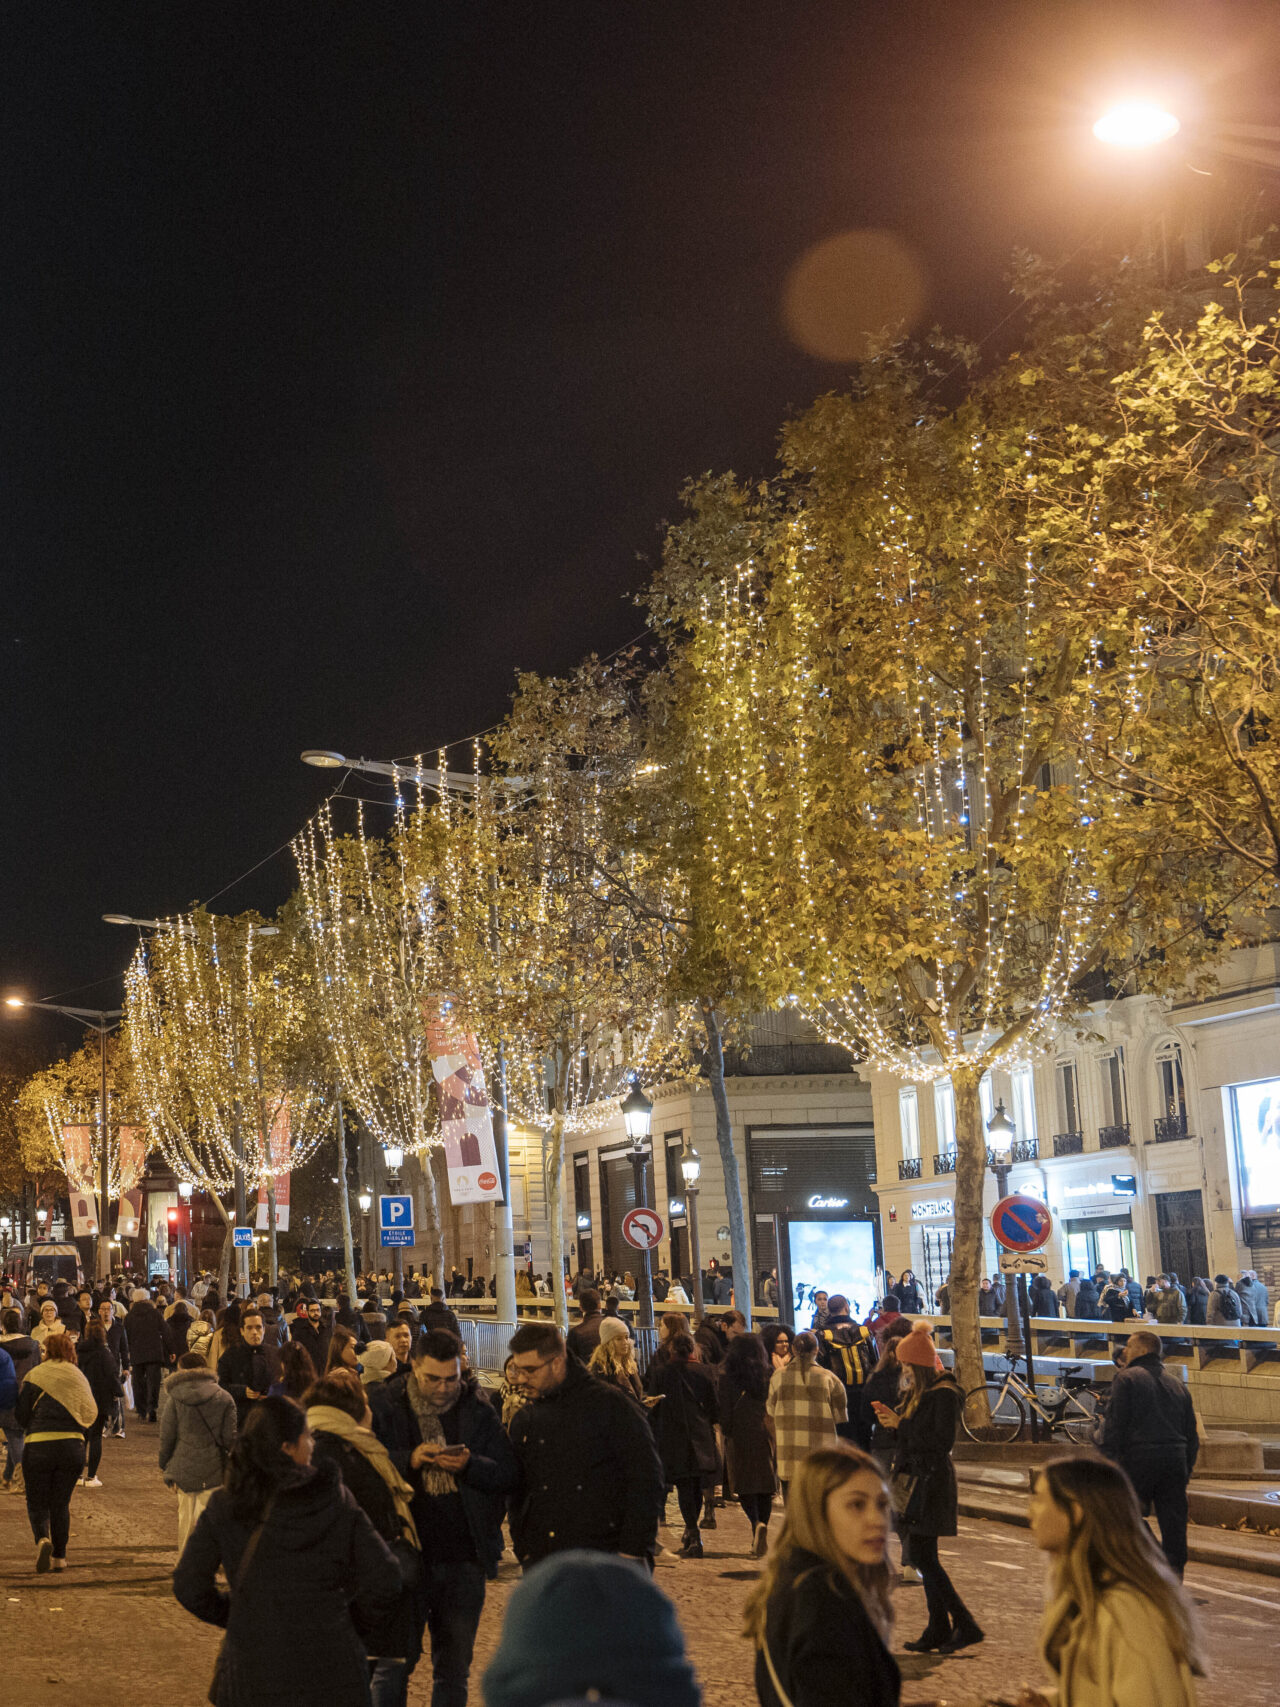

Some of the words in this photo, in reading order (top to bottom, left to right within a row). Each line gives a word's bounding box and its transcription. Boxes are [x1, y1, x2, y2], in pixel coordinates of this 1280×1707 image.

[808, 1195, 849, 1208] Cartier
[912, 1200, 953, 1218] MONTBLANC
[390, 1202, 404, 1223] P
